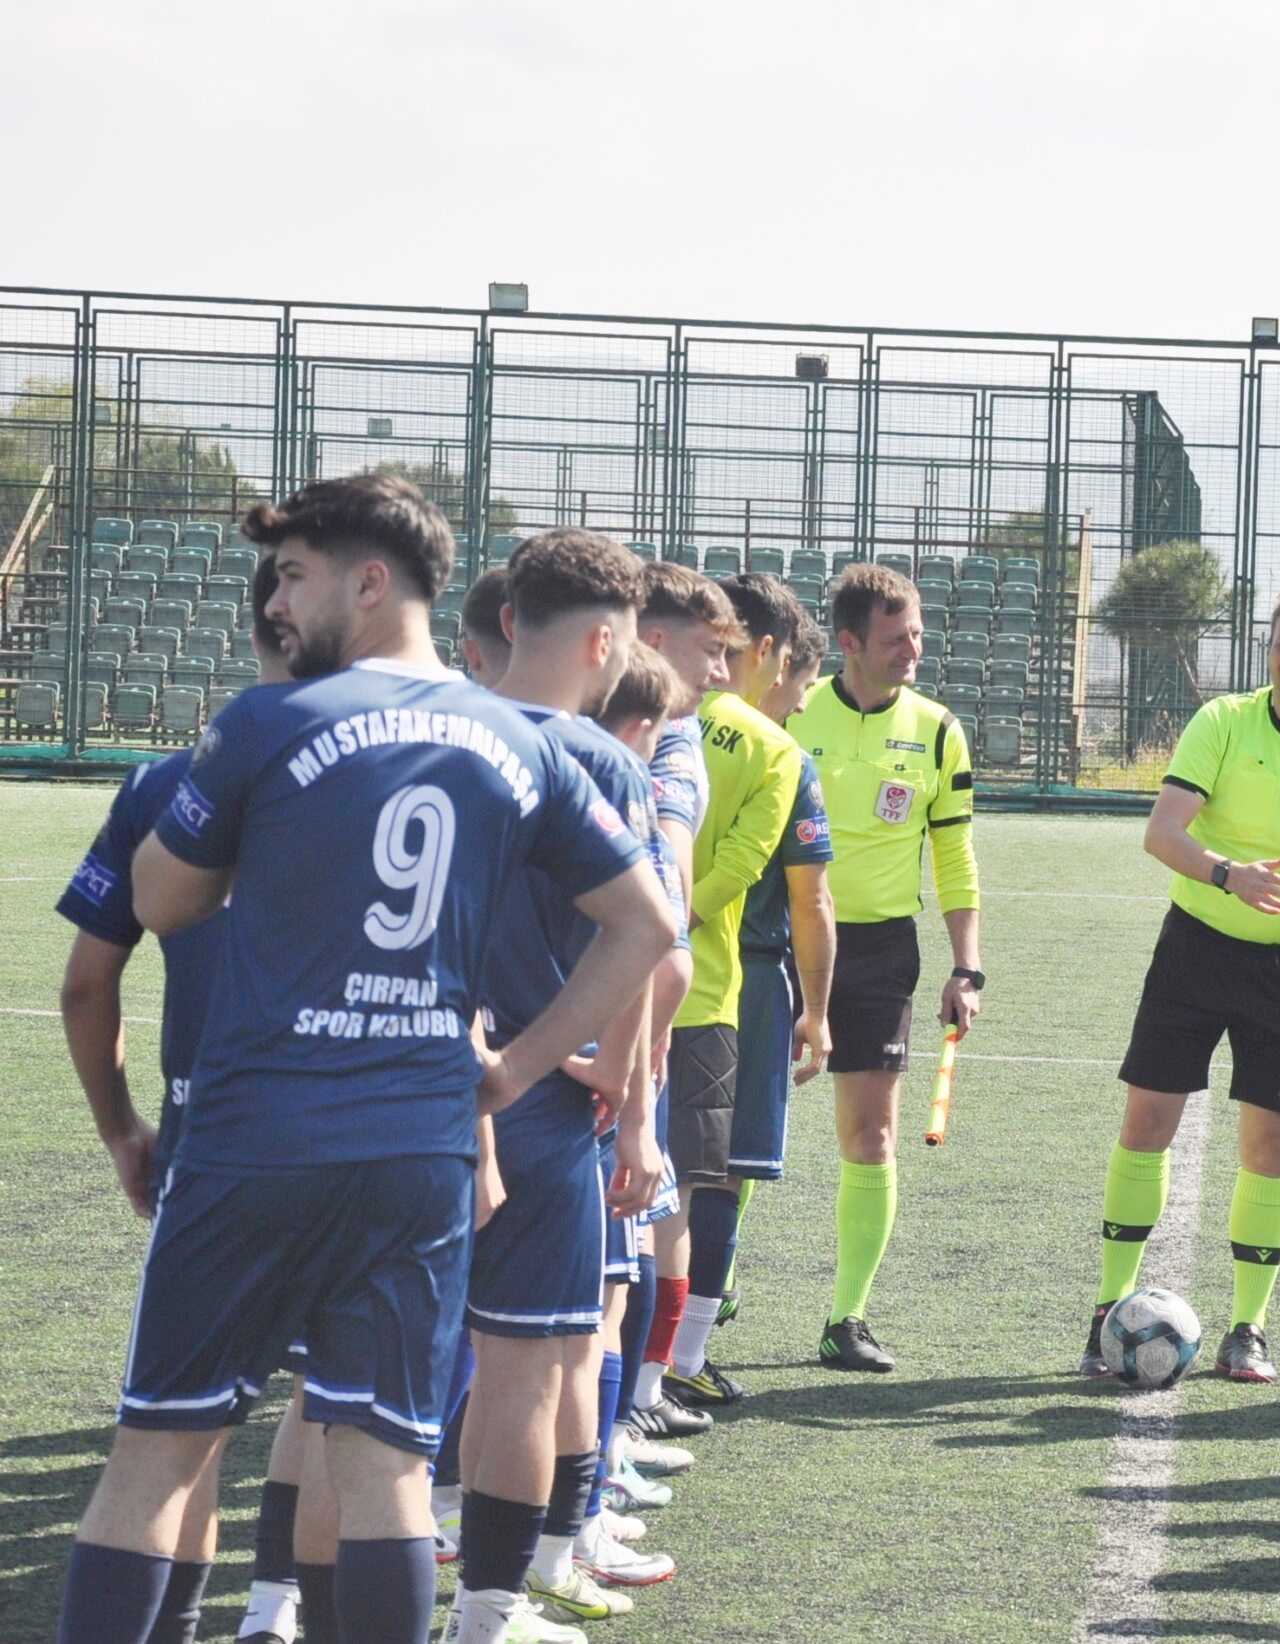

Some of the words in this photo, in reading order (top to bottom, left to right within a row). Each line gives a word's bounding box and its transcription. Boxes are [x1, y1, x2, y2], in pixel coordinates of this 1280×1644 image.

[711, 724, 744, 754] SK
[882, 808, 902, 820] TFF
[363, 785, 456, 950] 9
[344, 972, 438, 1007] ÇIRPAN
[293, 1008, 365, 1039] SPOR
